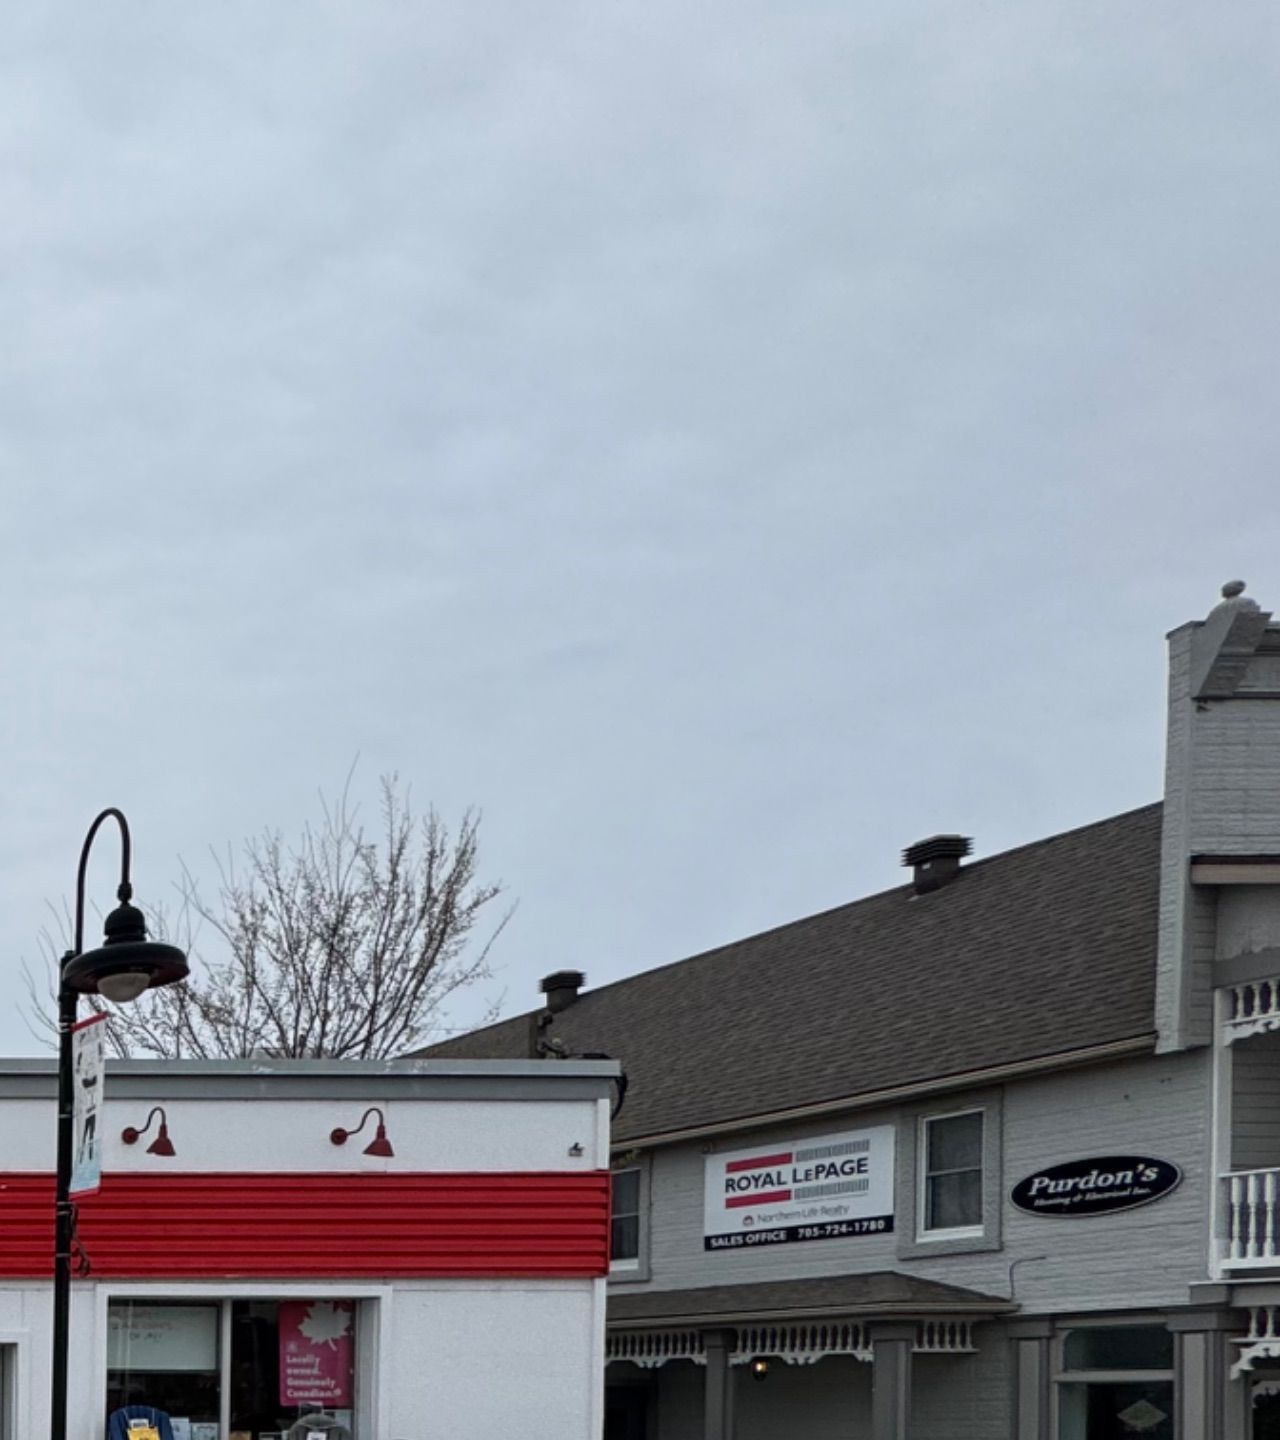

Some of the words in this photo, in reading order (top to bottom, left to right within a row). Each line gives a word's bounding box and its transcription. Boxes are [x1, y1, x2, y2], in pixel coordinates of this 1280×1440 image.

[725, 1170, 787, 1193] ROYAL
[1027, 1163, 1160, 1196] Purdon's
[820, 1204, 850, 1218] Realty
[710, 1234, 743, 1248] SALES
[746, 1230, 787, 1245] OFFICE
